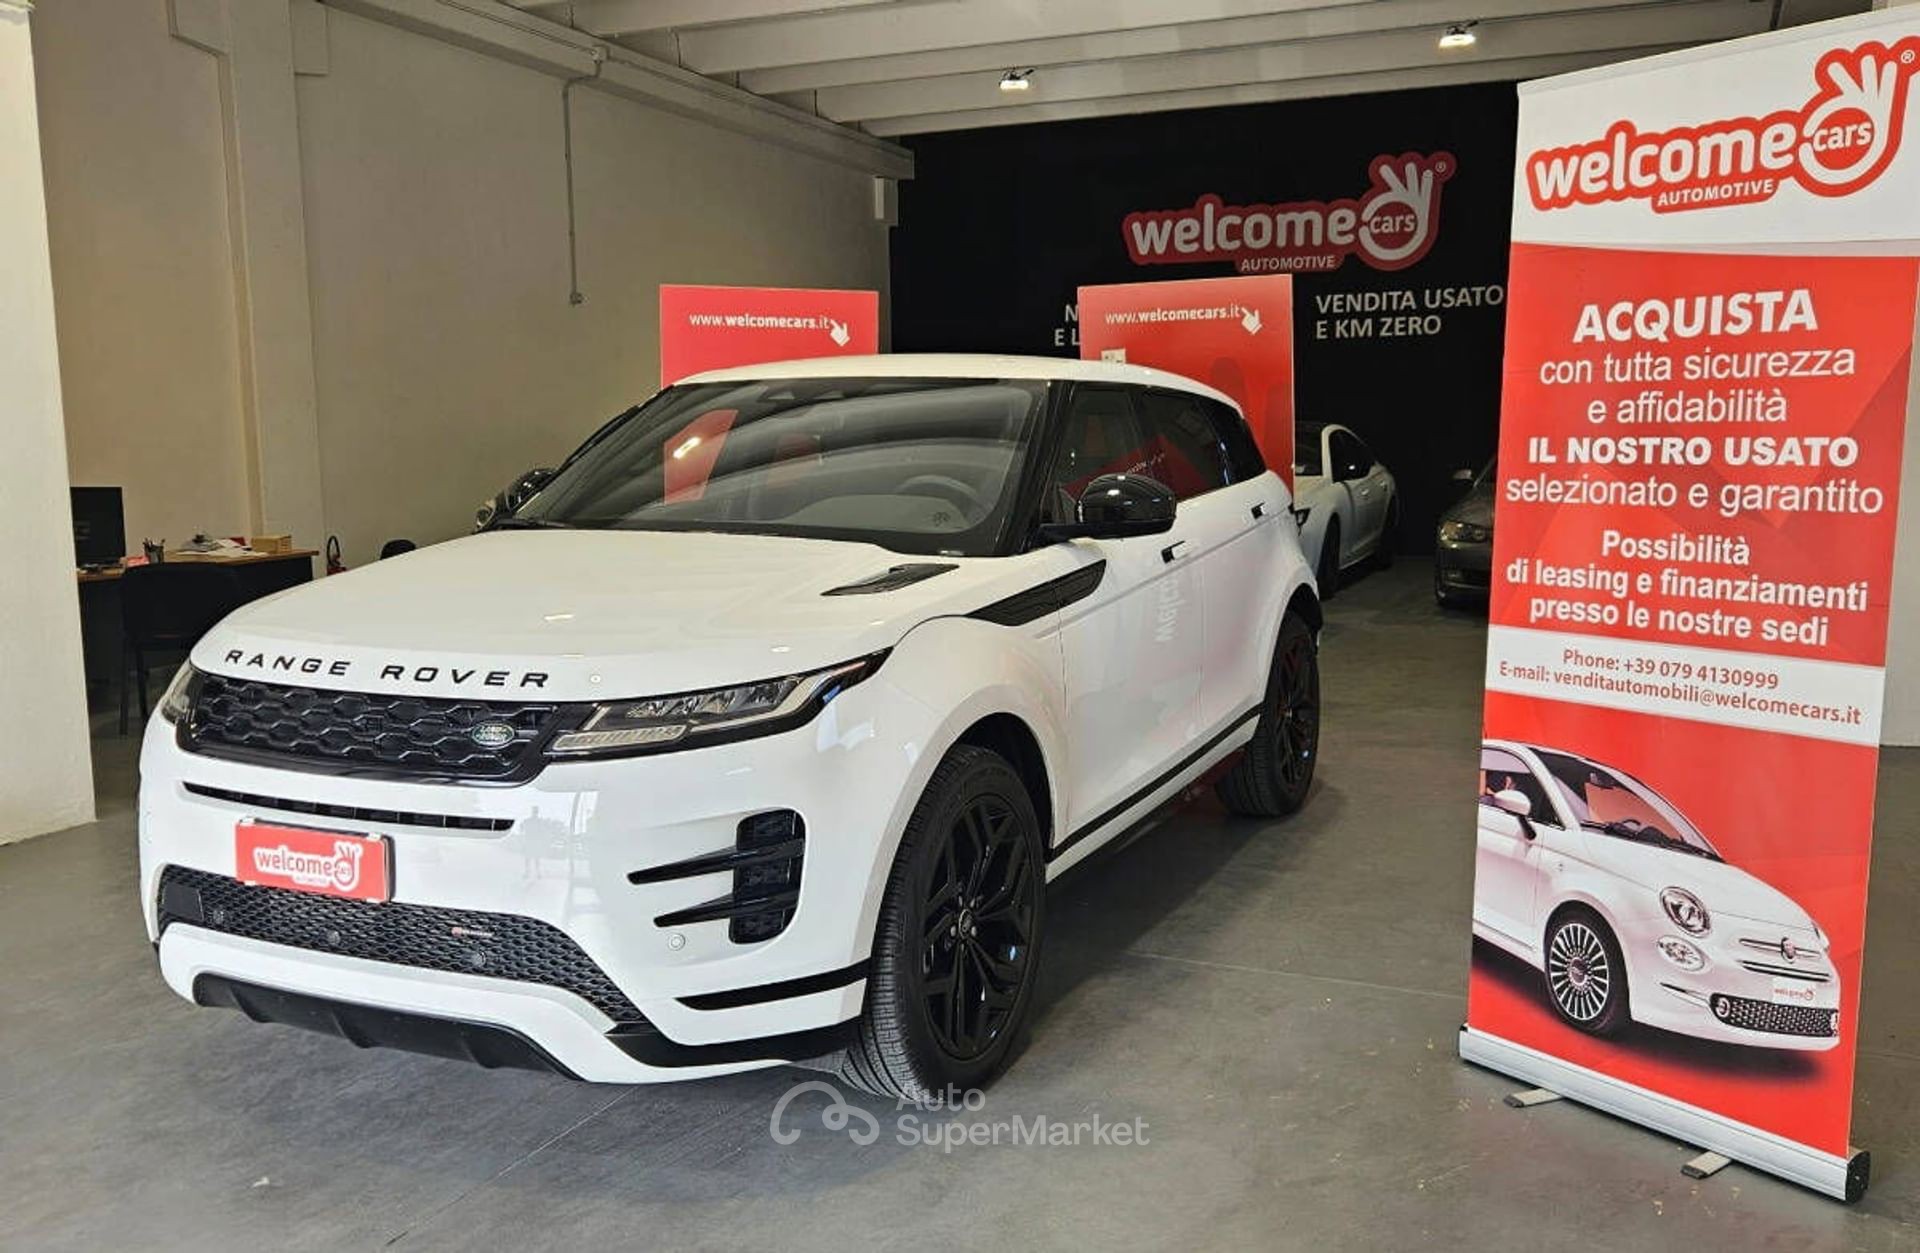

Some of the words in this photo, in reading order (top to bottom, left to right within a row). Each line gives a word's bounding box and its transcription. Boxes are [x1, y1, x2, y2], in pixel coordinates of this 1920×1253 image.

[1535, 123, 1797, 200] welcome
[1813, 122, 1873, 152] cars
[1657, 178, 1774, 206] AUTOMOTIVE
[1132, 203, 1356, 256] welcome
[1368, 210, 1416, 235] cars
[1241, 255, 1336, 272] AUTOMOTIVE
[1105, 306, 1240, 325] www.welcomecars.it
[1316, 289, 1417, 314] VENDITA
[1425, 285, 1504, 308] USATO
[1573, 289, 1818, 343] ACQUISTA
[689, 313, 831, 330] www.welcomecars.it
[1315, 320, 1328, 340] E
[1335, 318, 1373, 338] KM
[1379, 315, 1442, 337] ZERO
[1540, 358, 1592, 385] con
[1604, 351, 1672, 382] tutta
[1683, 346, 1856, 380] sicurezza
[1587, 400, 1607, 424] e
[1617, 387, 1787, 424] affidabilità
[1528, 437, 1556, 464] IL
[1567, 437, 1711, 466] NOSTRO
[1724, 437, 1859, 468] USATO
[1506, 474, 1677, 508] selezionato
[1688, 483, 1709, 508] e
[1720, 480, 1884, 517] garantito
[1602, 530, 1750, 566] Possibilità
[1506, 558, 1528, 584] di
[1535, 560, 1629, 595] leasing
[1637, 574, 1652, 594] e
[1660, 568, 1869, 612] finanziamenti
[1530, 597, 1619, 625] presso
[1627, 601, 1650, 628] le
[1659, 608, 1752, 639] nostre
[1762, 616, 1829, 647] sedi
[224, 649, 352, 677] RANGE
[380, 664, 549, 689] ROVER
[1563, 648, 1620, 671] Phone:
[1624, 656, 1655, 674] +39
[1660, 660, 1692, 679] 079
[1697, 663, 1778, 690] 4130999
[1500, 661, 1550, 684] E-mail:
[1554, 670, 1861, 725] venditautomobili@welcomecars.it
[256, 850, 333, 876] welcome
